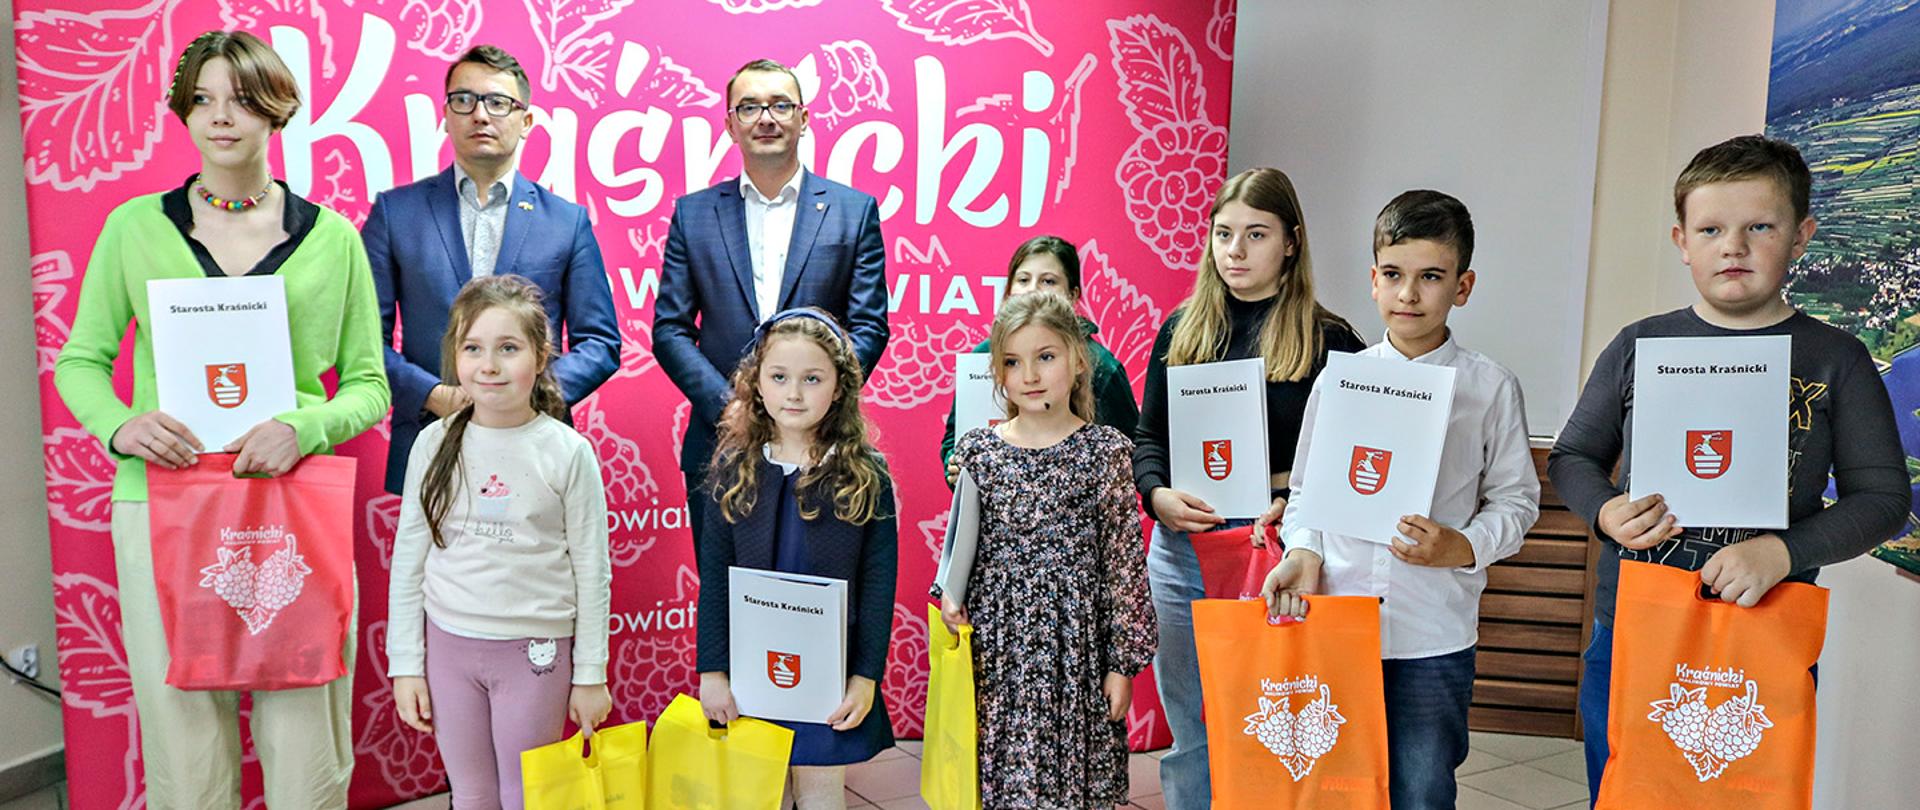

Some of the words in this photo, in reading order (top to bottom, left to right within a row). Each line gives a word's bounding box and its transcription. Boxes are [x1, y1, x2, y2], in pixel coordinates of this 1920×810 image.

[170, 304, 214, 313] Starosta
[217, 301, 267, 312] Kraśnicki
[1657, 365, 1706, 374] Starosta
[1709, 363, 1767, 373] Kraśnicki
[1180, 388, 1211, 397] Starosta
[1213, 383, 1248, 394] Kraśnicki
[1340, 379, 1381, 393] Starosta
[1383, 385, 1433, 401] Kraśnicki
[743, 595, 779, 608] Starosta
[781, 602, 824, 615] Kraśnicki
[1260, 673, 1318, 691] Kraśnicki
[1676, 663, 1744, 683] Kraśnicki
